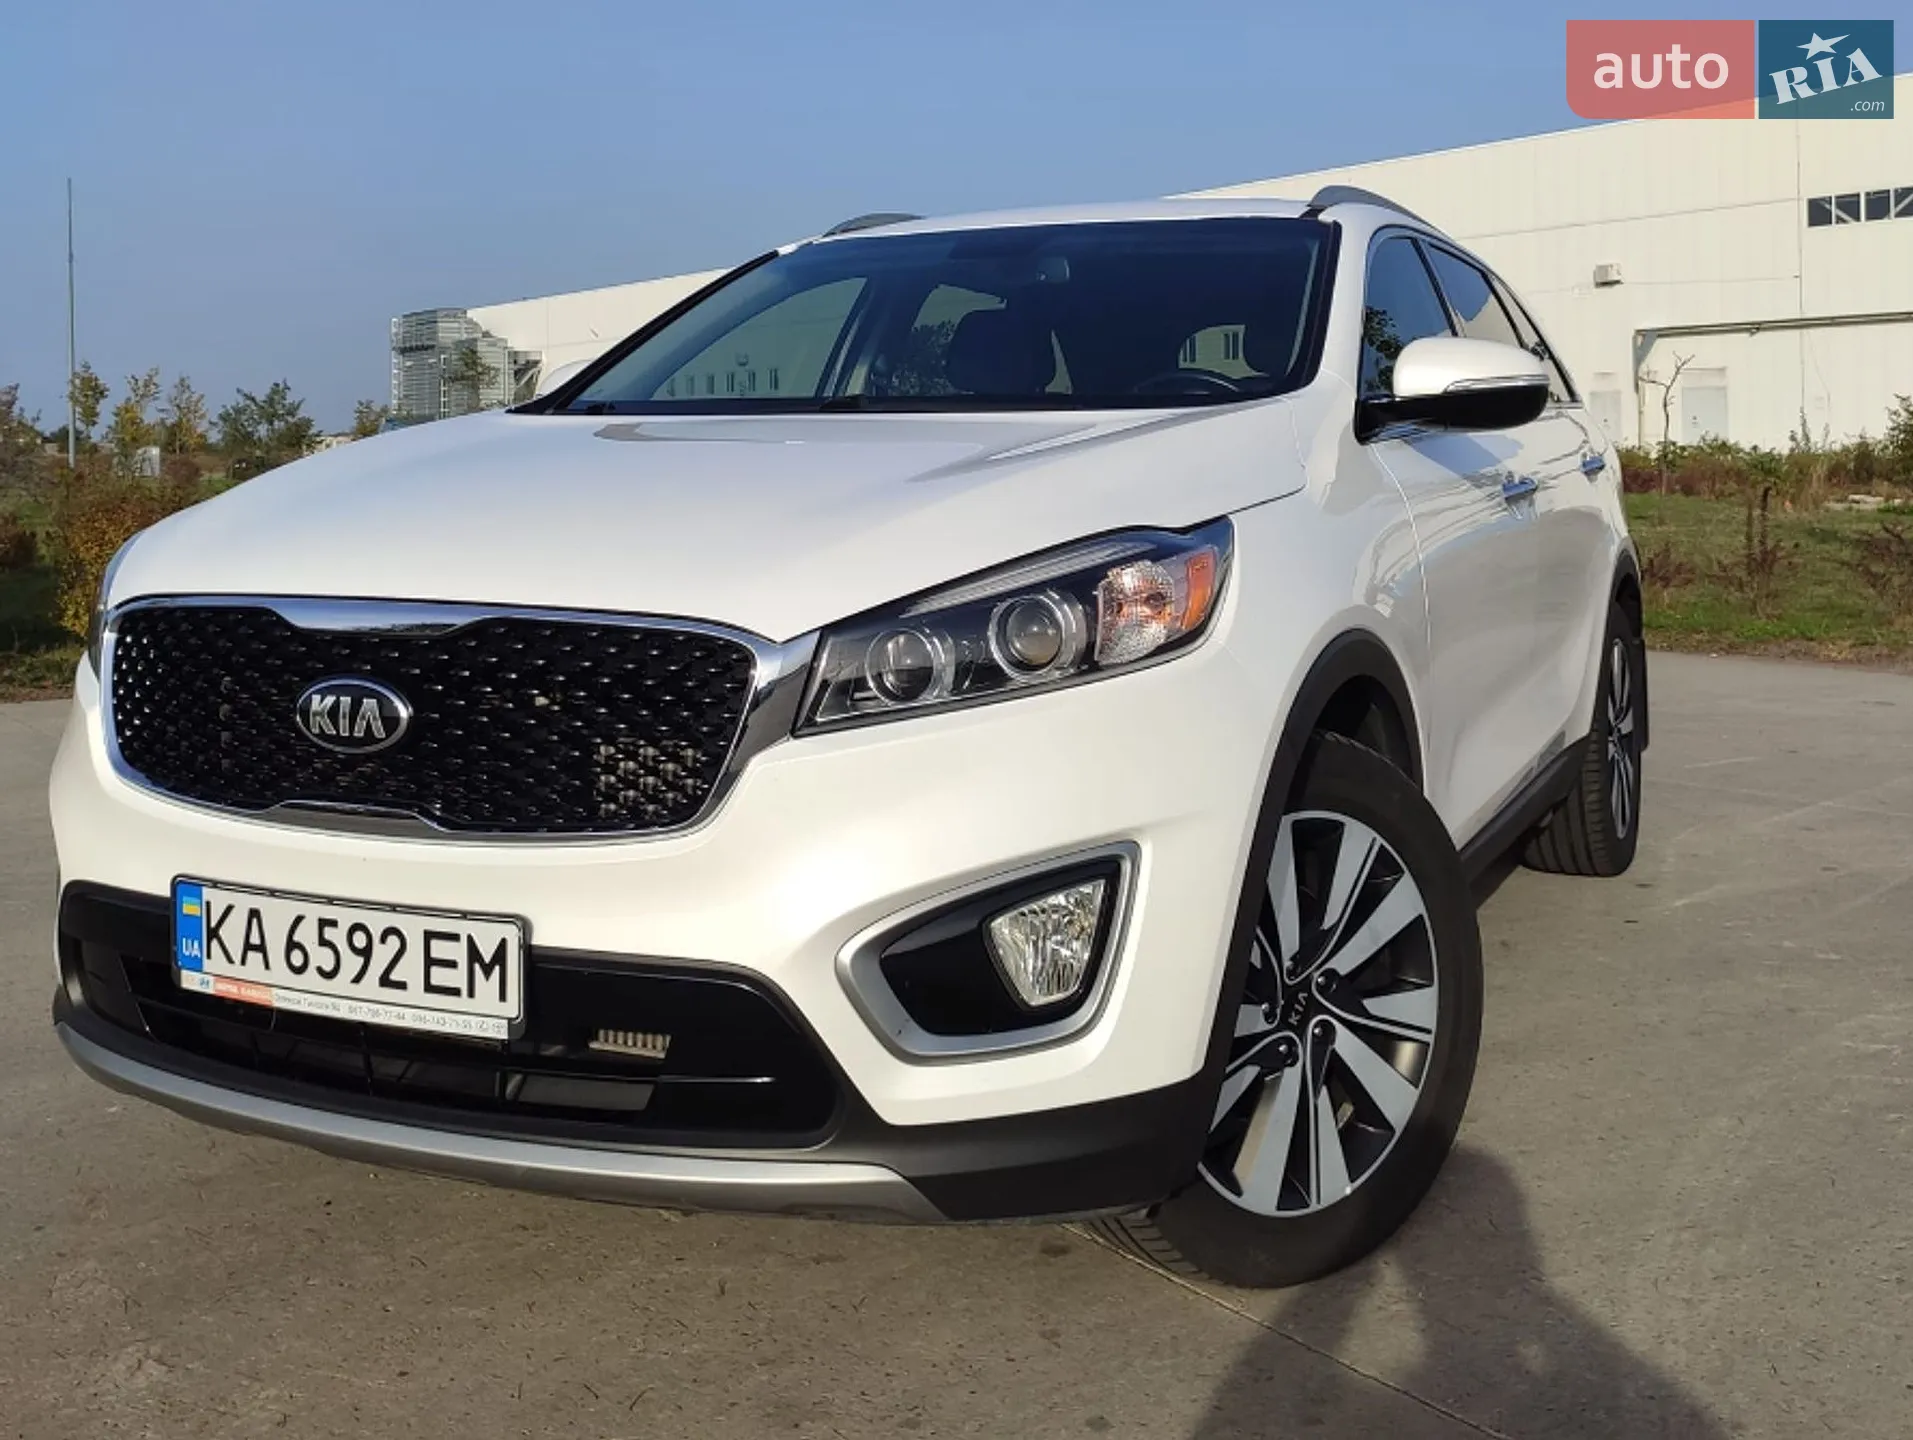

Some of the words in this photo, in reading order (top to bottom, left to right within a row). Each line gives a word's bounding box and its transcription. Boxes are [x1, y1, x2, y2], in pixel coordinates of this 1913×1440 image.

[309, 694, 386, 739] KIA
[182, 937, 201, 958] UA
[205, 900, 271, 971] KA
[284, 914, 408, 992] 6592
[423, 928, 508, 1003] EM
[1287, 992, 1308, 1026] KIA
